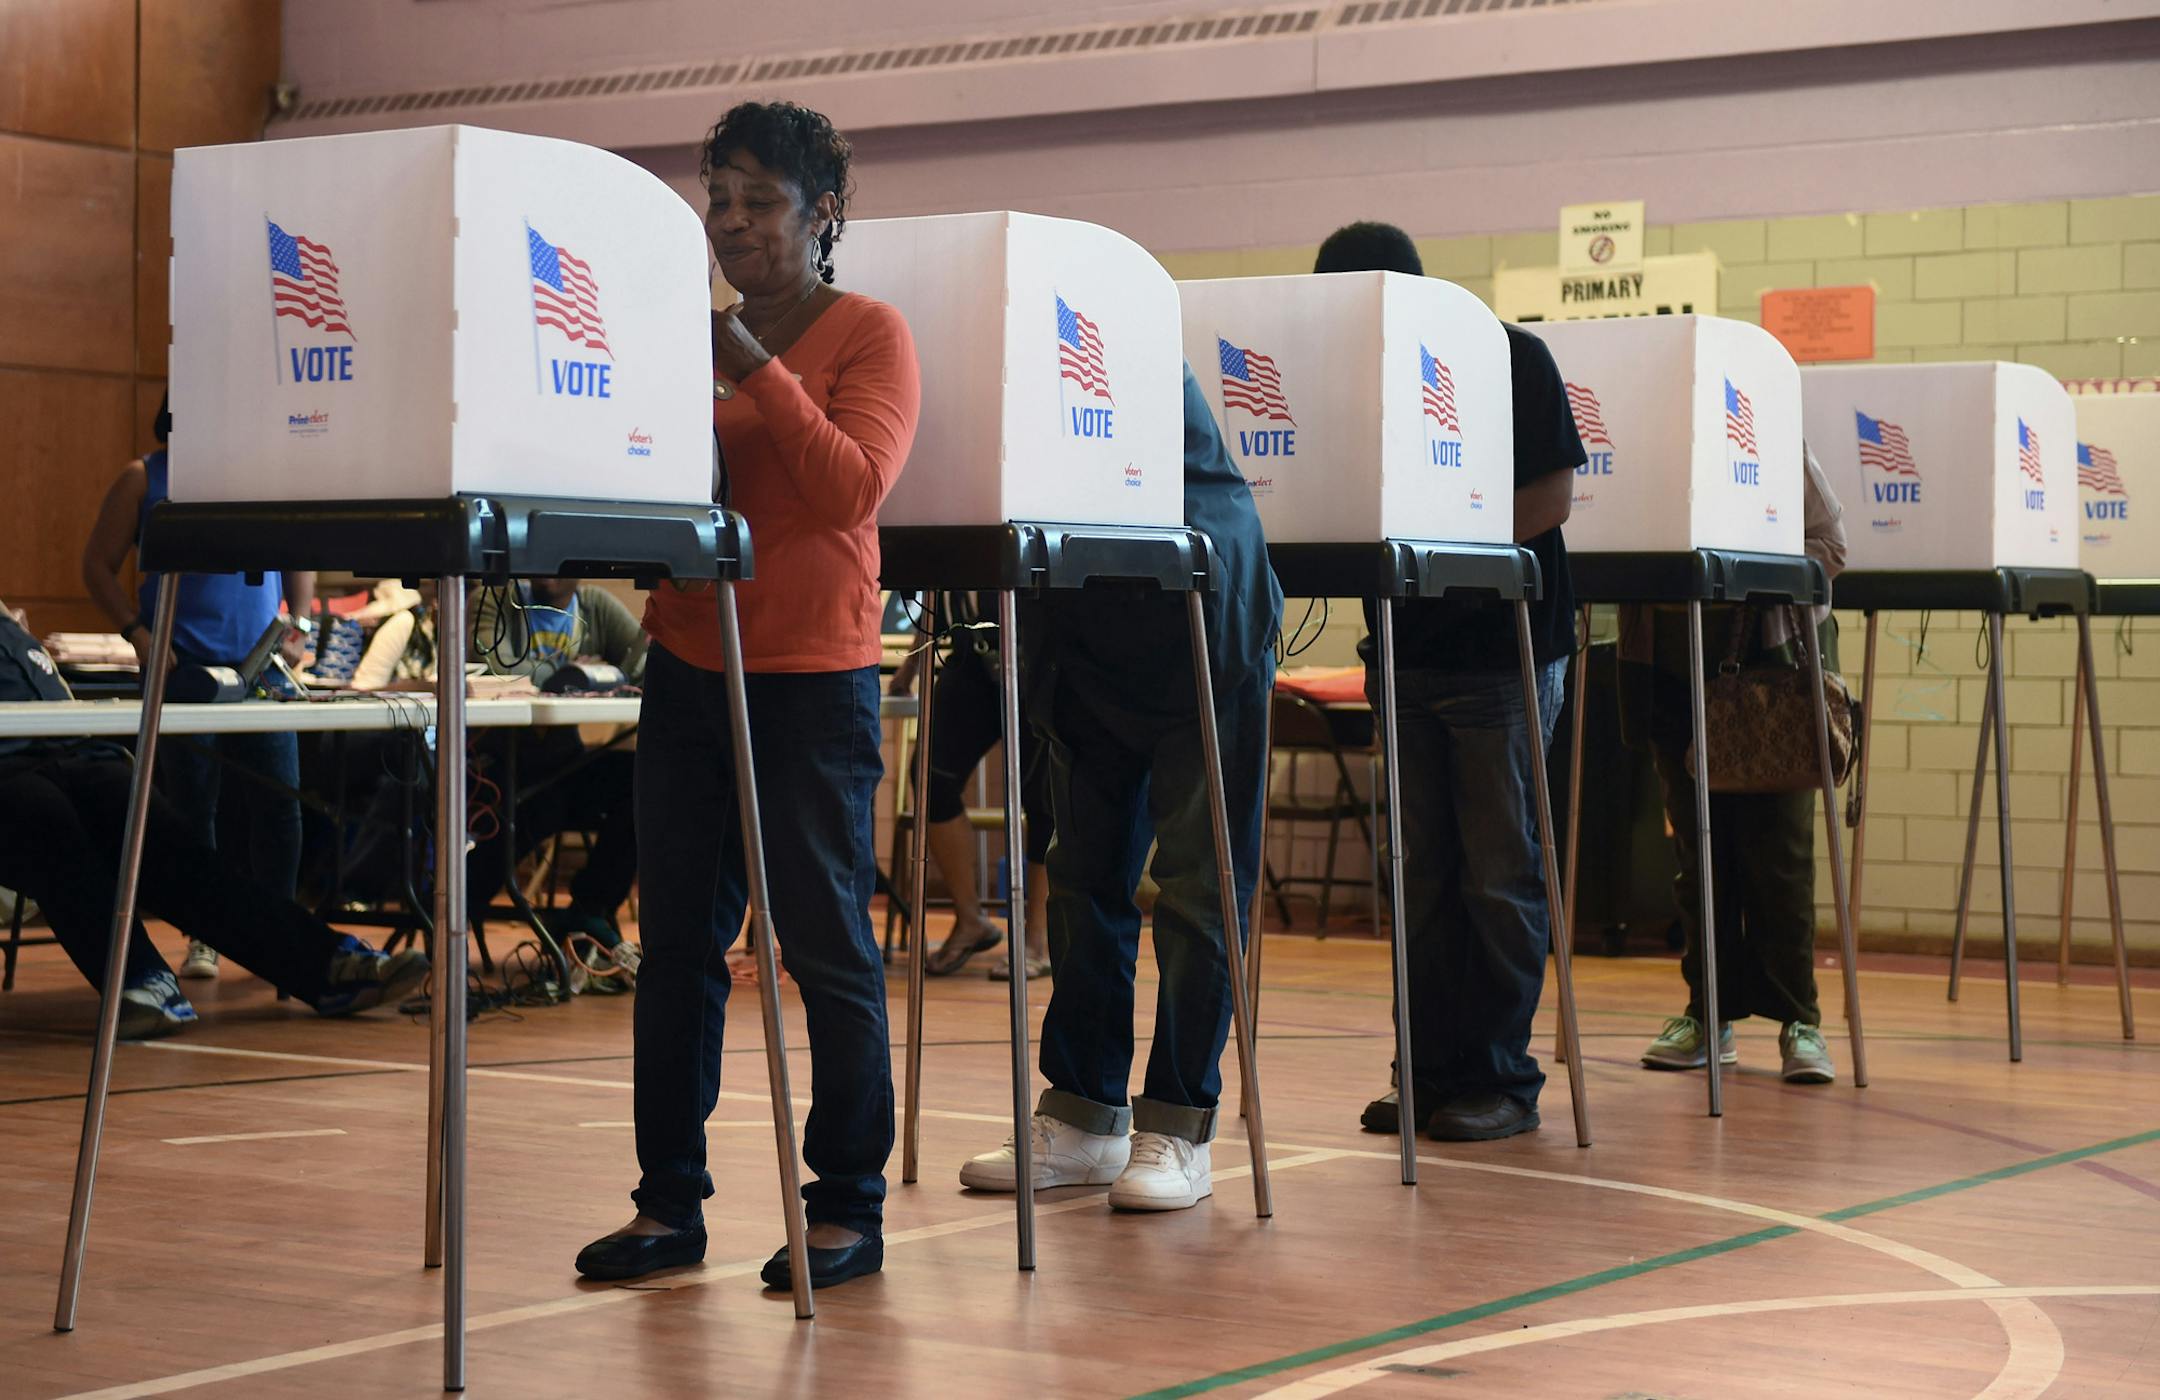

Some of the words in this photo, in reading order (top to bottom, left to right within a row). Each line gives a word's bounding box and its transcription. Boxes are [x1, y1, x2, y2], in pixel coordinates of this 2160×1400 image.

[1561, 273, 1643, 303] PRIMARY
[290, 345, 353, 382] VOTE
[552, 358, 611, 398] VOTE
[1072, 406, 1113, 438] VOTE
[1240, 430, 1295, 456] VOTE
[1432, 439, 1462, 467] VOTE
[1576, 452, 1613, 475] OTE
[1734, 461, 1759, 485] VOTE
[1874, 482, 1921, 502] VOTE
[2025, 490, 2045, 510] VOTE
[2085, 500, 2127, 519] VOTE
